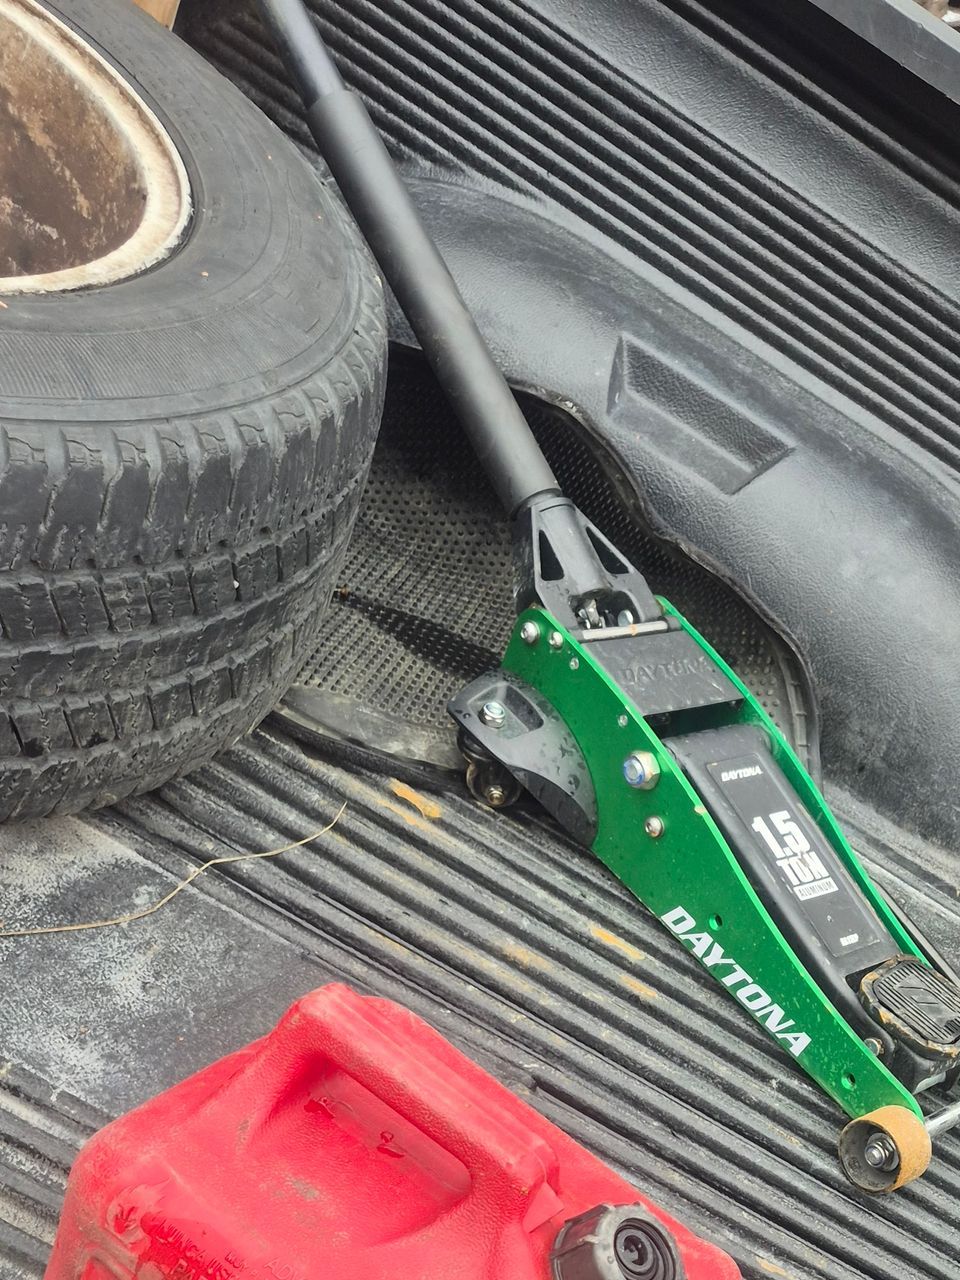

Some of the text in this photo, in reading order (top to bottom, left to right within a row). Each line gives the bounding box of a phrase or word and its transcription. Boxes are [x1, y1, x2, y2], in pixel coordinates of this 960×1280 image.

[721, 765, 764, 782] DAYTONA
[752, 810, 811, 859] 1.5
[776, 852, 830, 886] TON
[800, 880, 835, 898] ALUMINUM
[661, 906, 812, 1057] DAYTONA
